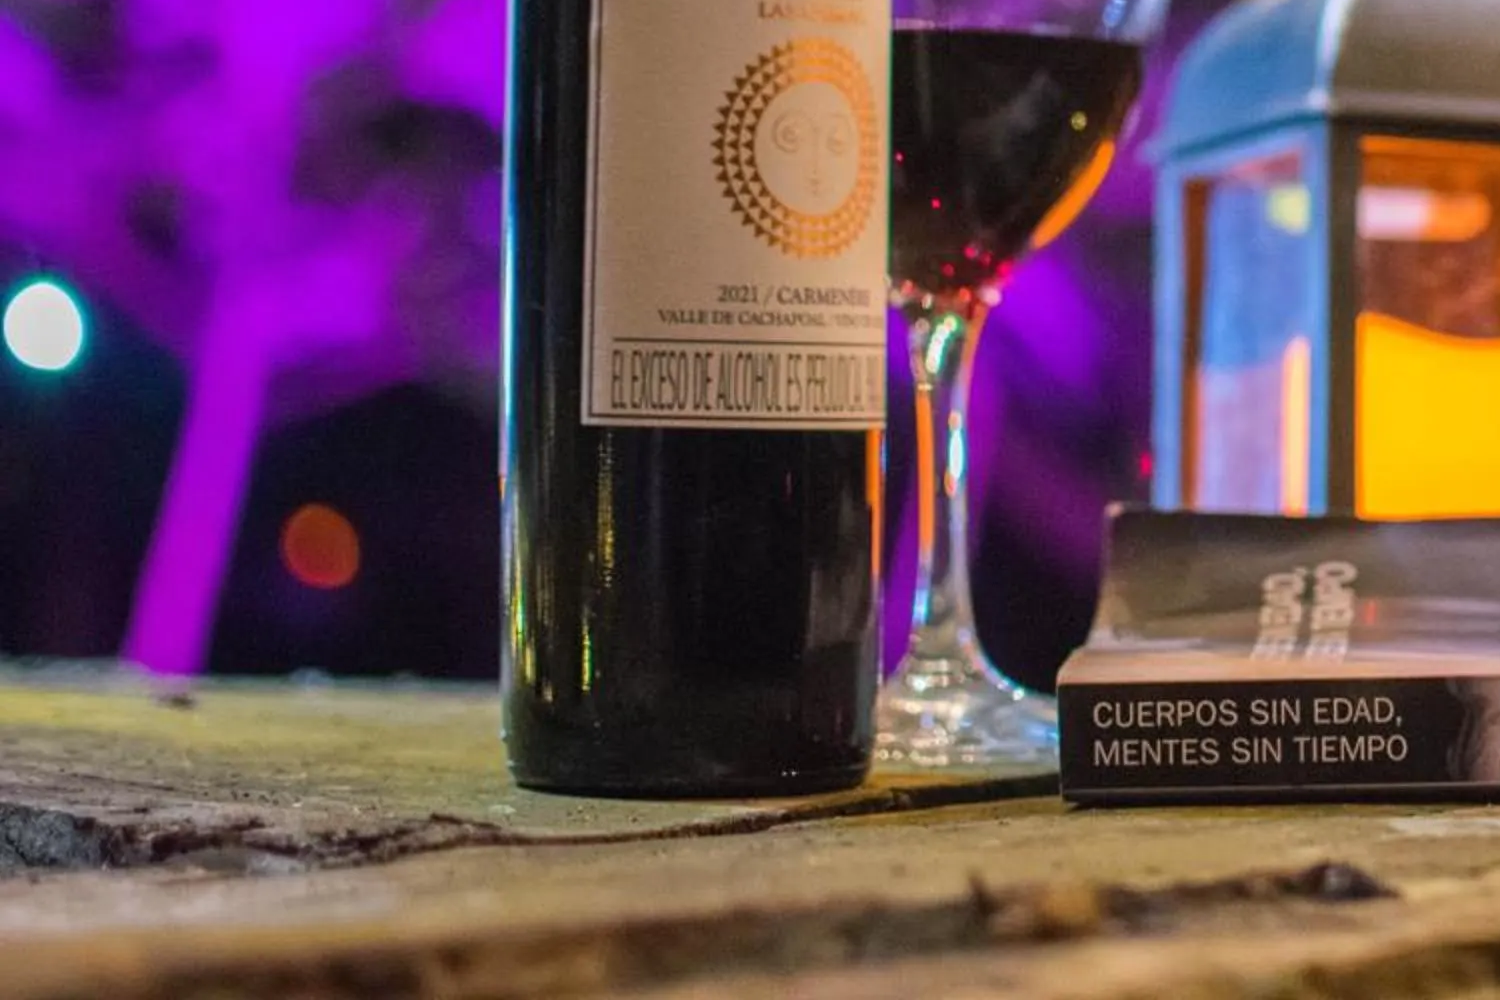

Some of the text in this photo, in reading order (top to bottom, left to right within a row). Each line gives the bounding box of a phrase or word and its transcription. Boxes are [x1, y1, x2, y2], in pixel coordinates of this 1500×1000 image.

[717, 285, 759, 303] 2021
[657, 309, 708, 325] VALLE
[711, 310, 735, 326] DE
[611, 350, 627, 409] EL
[630, 350, 689, 410] EXCESO
[693, 351, 712, 411] DE
[715, 352, 783, 412] ALCOHOL
[785, 353, 802, 413] ES
[1092, 696, 1403, 729] CUERPOS SIN EDAD,
[1093, 733, 1409, 767] MENTES SIN TIEMPO
